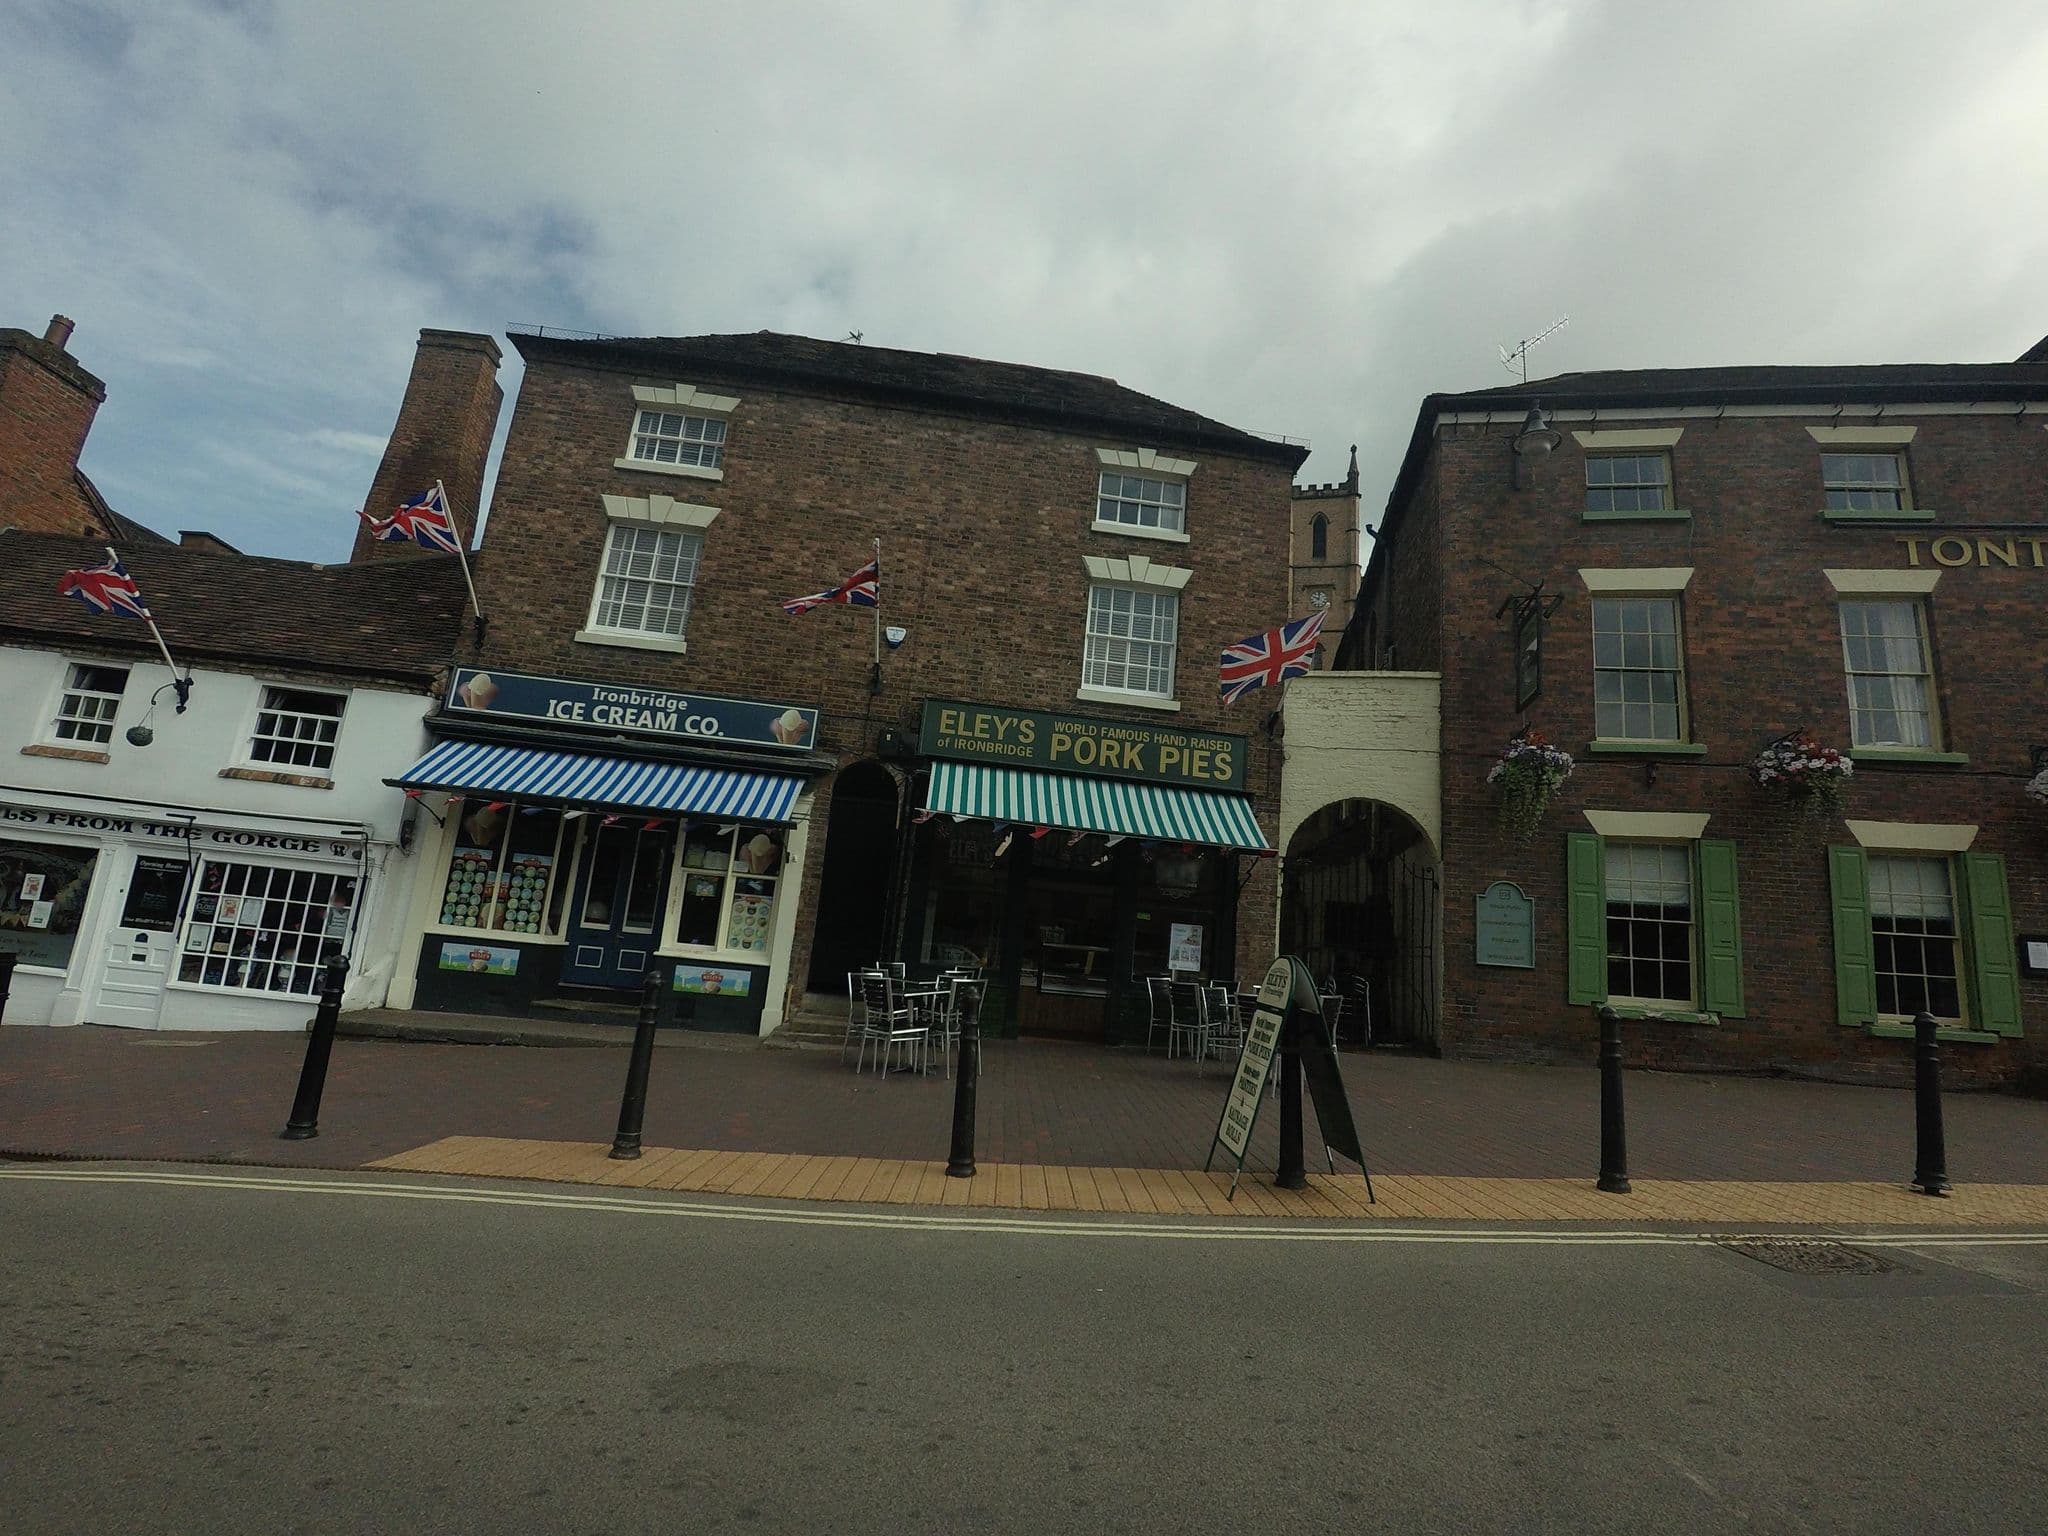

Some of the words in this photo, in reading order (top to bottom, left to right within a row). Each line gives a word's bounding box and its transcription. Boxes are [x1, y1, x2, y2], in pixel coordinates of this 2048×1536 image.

[1895, 535, 2048, 567] TONT
[592, 687, 688, 713] Ironbridge
[546, 699, 586, 720] ICE
[592, 705, 678, 731] CREAM
[684, 715, 725, 736] CO.
[939, 709, 1035, 743] ELEY'S
[937, 737, 952, 748] of
[954, 738, 1034, 758] IRONBRIDGE
[1054, 720, 1098, 736] WORLD
[1101, 726, 1150, 743] FAMOUS
[1154, 733, 1187, 747] HAND
[1190, 737, 1232, 752] RAISED
[1050, 733, 1145, 771] PORK
[1159, 746, 1233, 781] PIES
[46, 812, 134, 834] FROM
[142, 822, 202, 841] THE
[212, 831, 321, 853] GORGE
